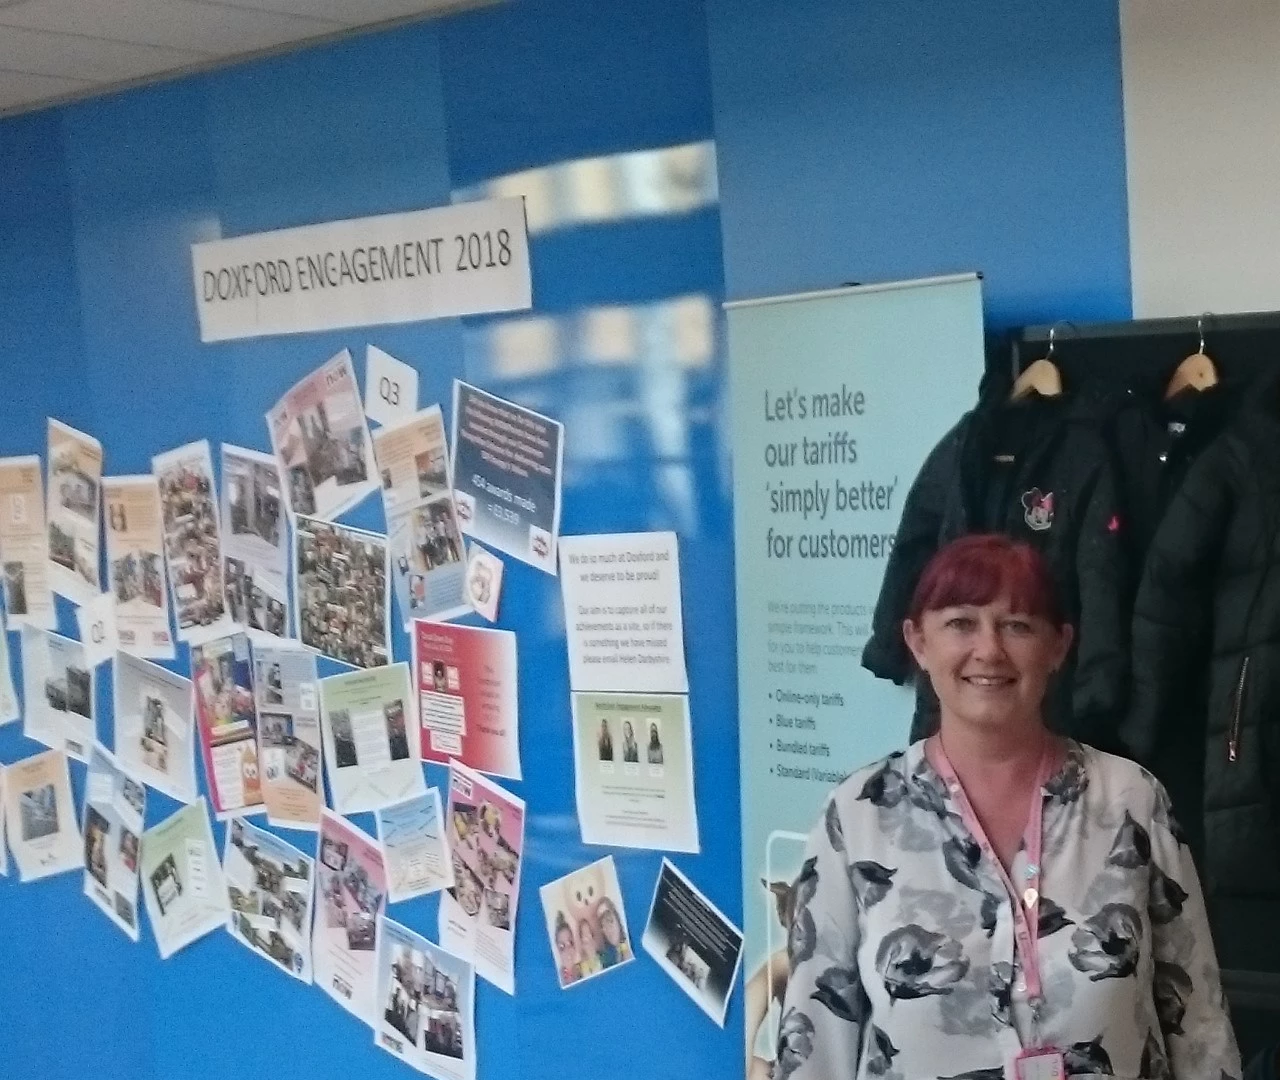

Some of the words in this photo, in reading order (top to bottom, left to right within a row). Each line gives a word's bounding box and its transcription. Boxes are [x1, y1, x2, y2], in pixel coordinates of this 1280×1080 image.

[203, 258, 293, 302] DOXFORD
[299, 238, 443, 291] ENGAGEMENT
[454, 228, 512, 272] 2018
[380, 377, 400, 405] Q3
[765, 387, 807, 421] Let's
[811, 384, 865, 418] make
[765, 442, 797, 467] our
[802, 431, 857, 465] tariffs
[766, 479, 830, 520] 'simply
[836, 475, 898, 511] better'
[767, 527, 793, 558] for
